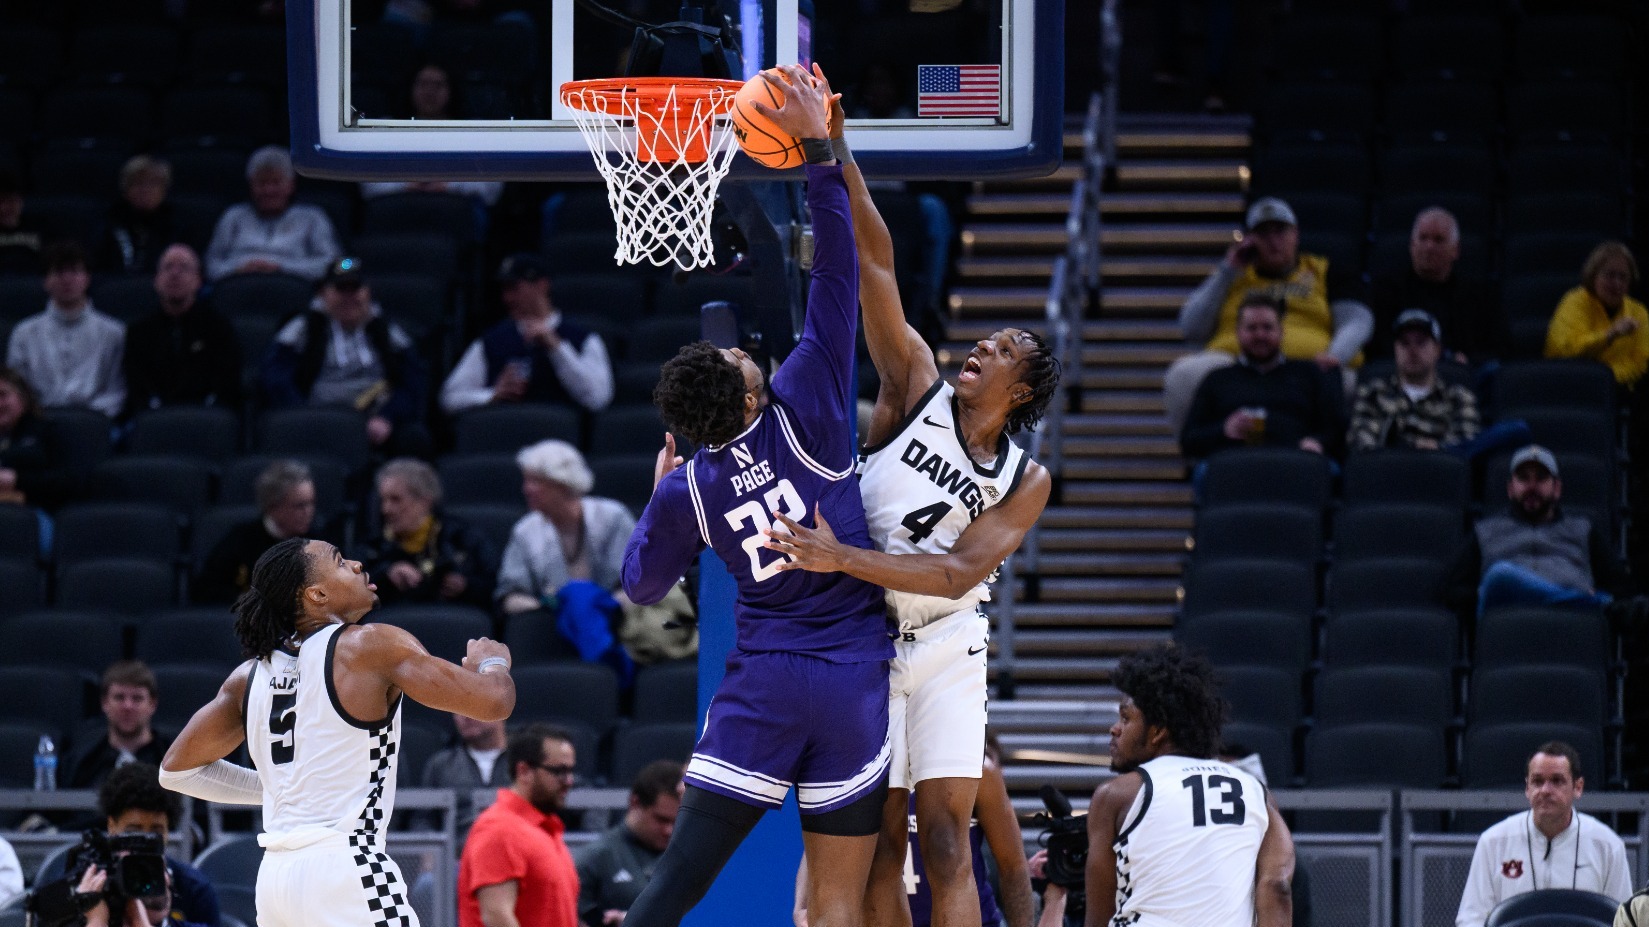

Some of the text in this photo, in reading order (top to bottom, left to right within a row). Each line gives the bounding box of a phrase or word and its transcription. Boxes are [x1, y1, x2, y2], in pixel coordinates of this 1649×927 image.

[730, 442, 755, 469] N
[730, 459, 776, 497] PAGE
[900, 500, 954, 545] 4
[901, 631, 917, 643] B
[268, 690, 298, 766] 5
[1181, 773, 1246, 827] 13
